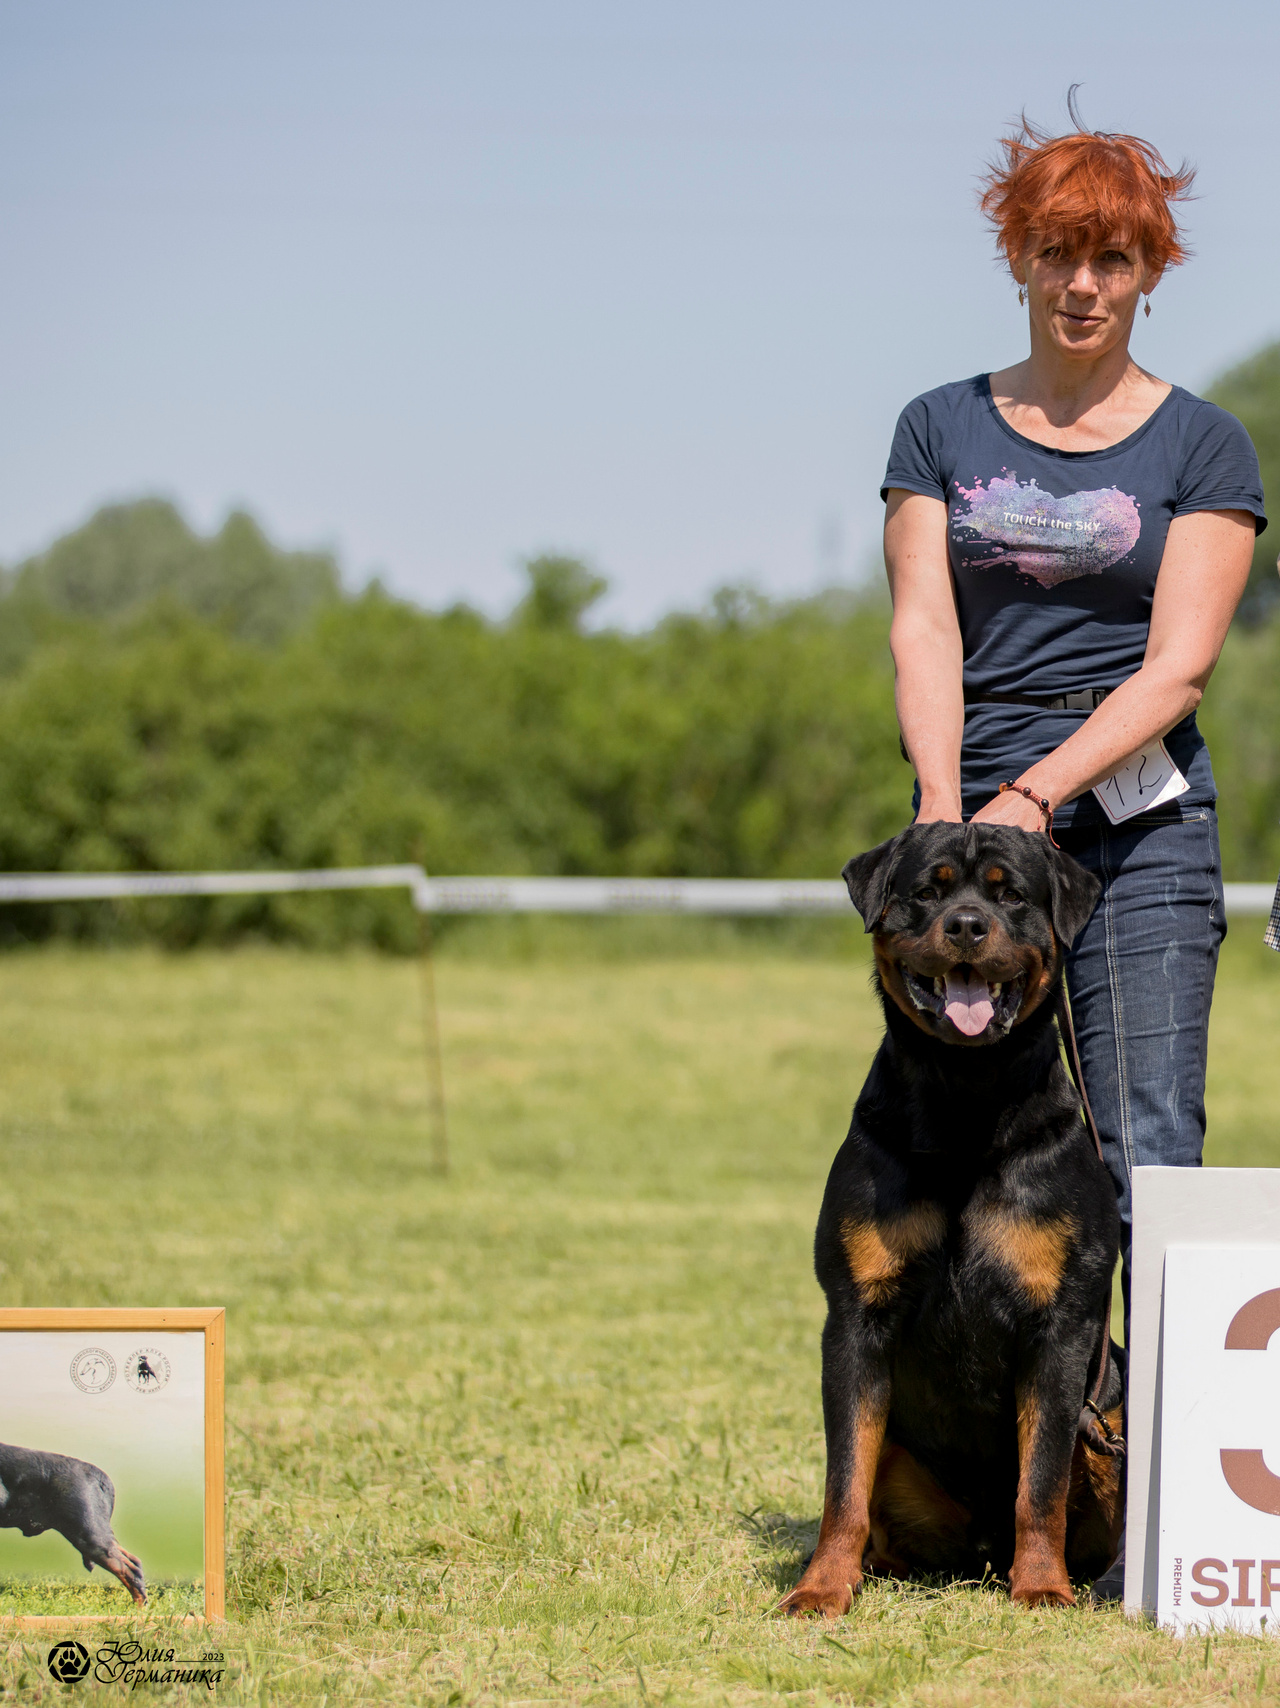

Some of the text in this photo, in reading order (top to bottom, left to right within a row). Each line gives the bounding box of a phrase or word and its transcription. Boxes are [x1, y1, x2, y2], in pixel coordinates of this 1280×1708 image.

[1003, 512, 1101, 532] TOUCH the SKY
[1173, 1557, 1183, 1607] PREMIUM
